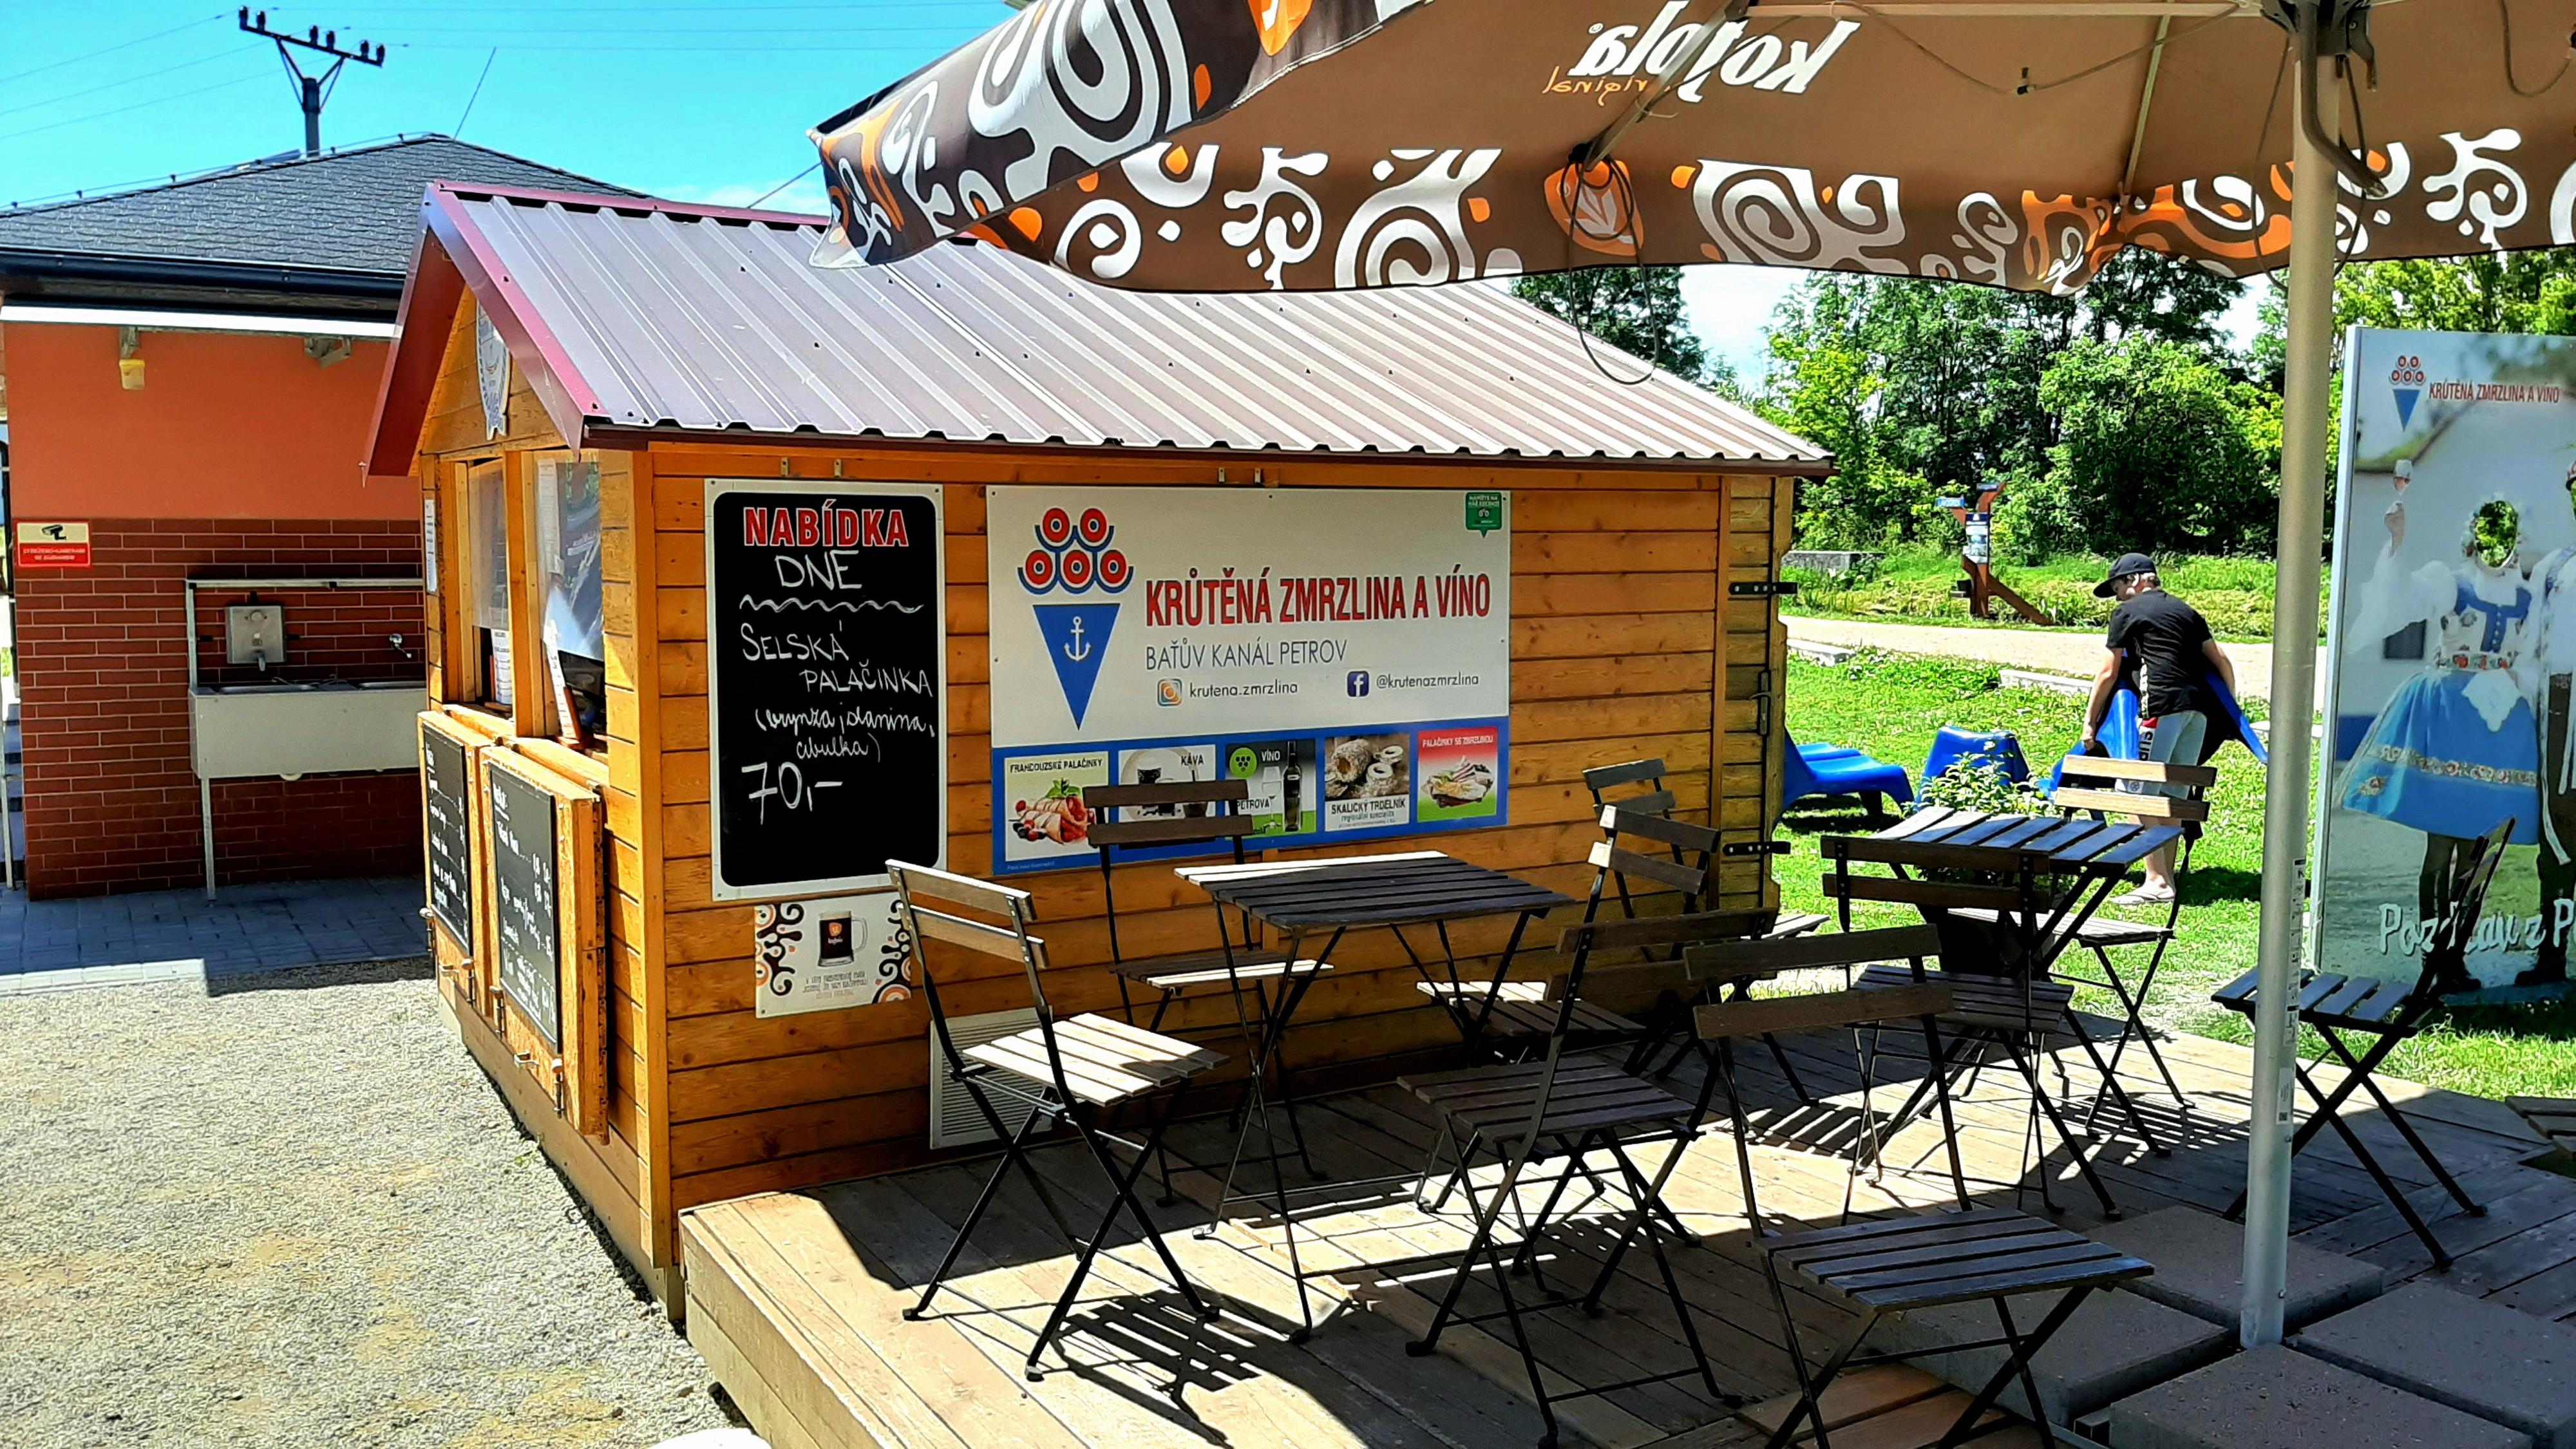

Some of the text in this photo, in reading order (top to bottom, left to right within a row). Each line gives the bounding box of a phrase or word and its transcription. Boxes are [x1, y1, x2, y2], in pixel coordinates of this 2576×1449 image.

[2477, 384, 2524, 402] ZMRZLINA
[2528, 385, 2534, 402] A
[743, 498, 909, 547] NABÍDKA
[774, 549, 862, 591] DNE
[1146, 564, 1491, 626] KRŮTĚNÁ ZMRZLINA A VÍNO
[741, 620, 849, 661] SELSKÁ
[1146, 637, 1347, 670] BAŤŮV KANÁL PETROV
[799, 658, 933, 697] PALAČINKA
[1376, 672, 1479, 690] @krutenazmrzlina
[1181, 752, 1204, 766] KÁVA
[1261, 749, 1280, 761] VÍNO
[1331, 797, 1405, 814] SKALICKÝ TRDELNÍK
